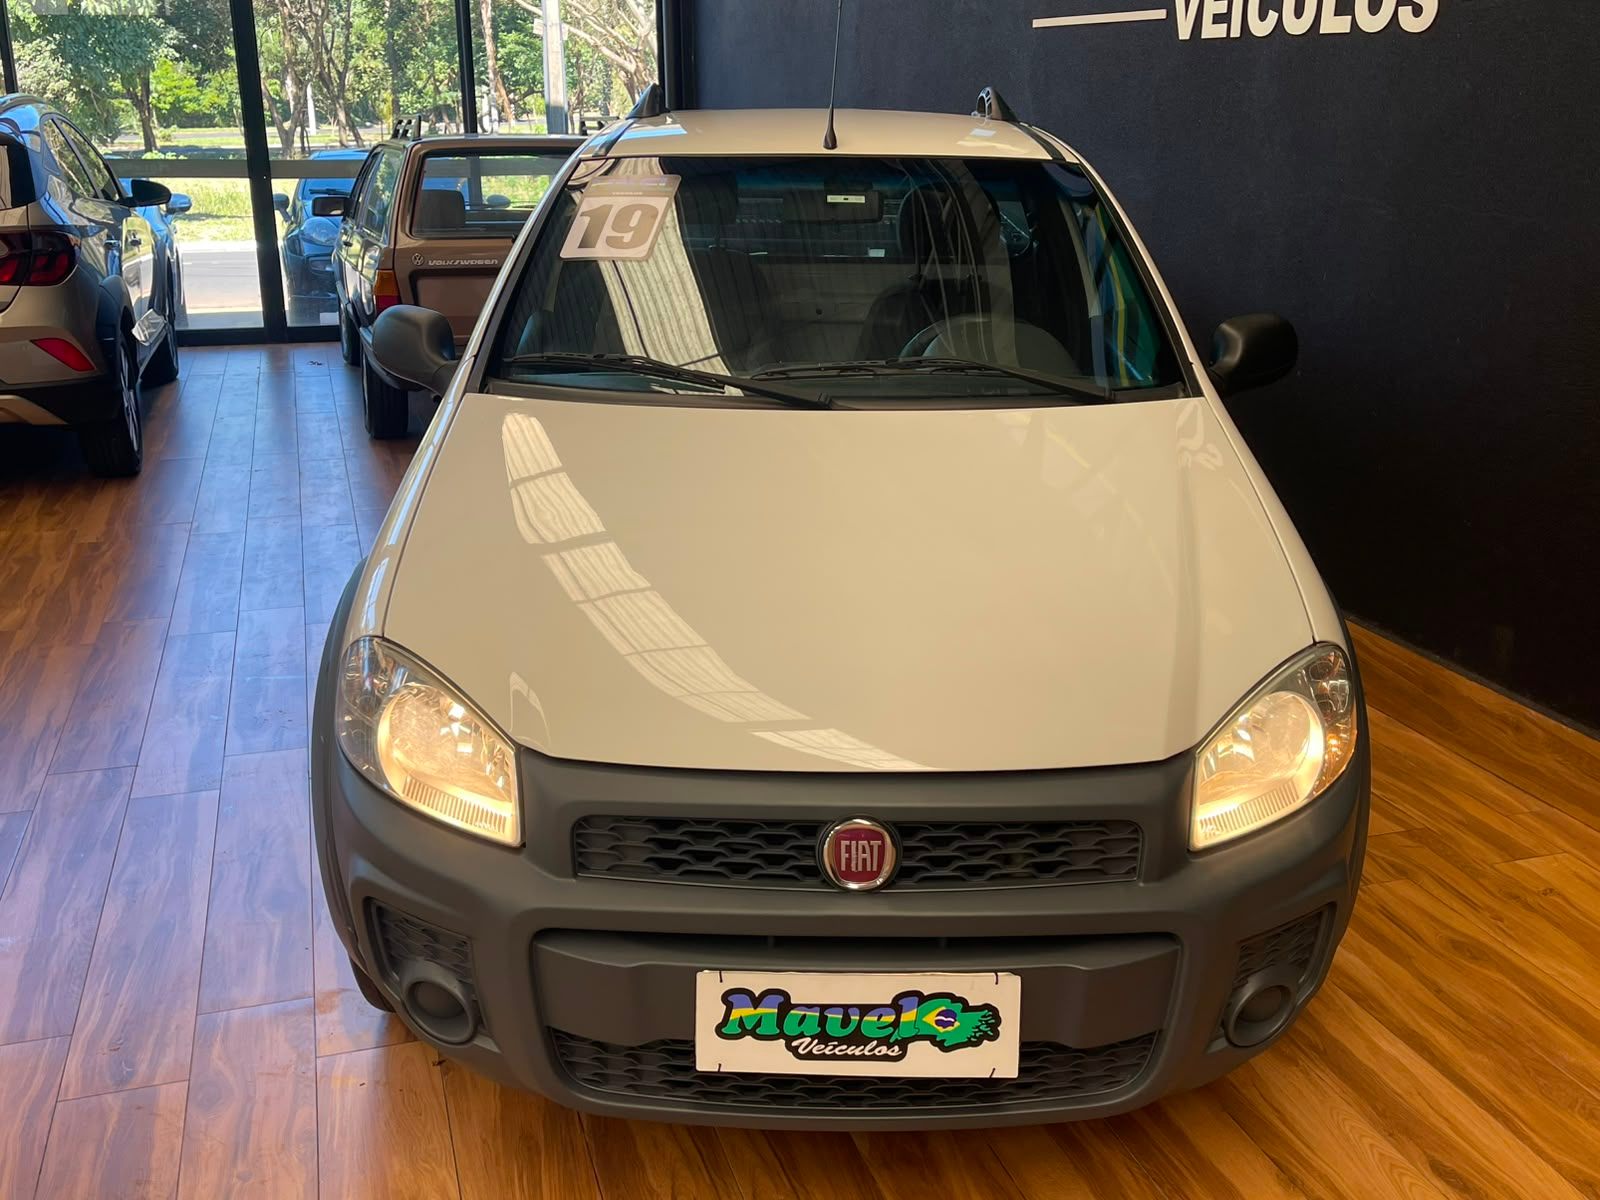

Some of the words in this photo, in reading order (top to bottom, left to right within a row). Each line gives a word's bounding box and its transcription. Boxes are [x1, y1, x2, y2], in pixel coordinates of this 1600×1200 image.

[578, 203, 659, 250] 19
[840, 840, 882, 872] FIAT
[720, 993, 921, 1043] Mavel
[791, 1037, 903, 1057] Veículos
